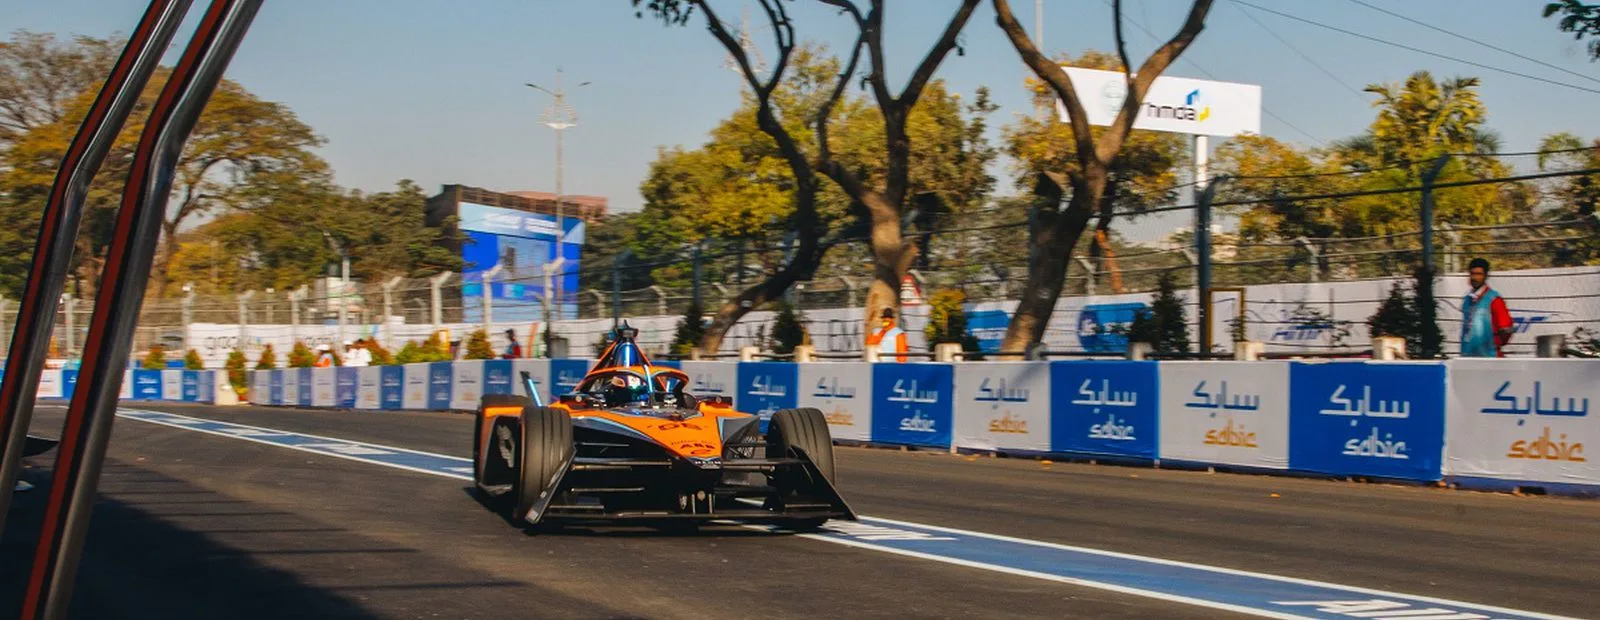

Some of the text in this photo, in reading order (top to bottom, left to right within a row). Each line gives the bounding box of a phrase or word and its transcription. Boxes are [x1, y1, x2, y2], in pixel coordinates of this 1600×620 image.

[1184, 380, 1260, 417] سابك
[1319, 385, 1410, 426] سابك
[1481, 381, 1588, 426] سابك
[988, 410, 1029, 434] sabic
[1088, 414, 1136, 440] sabic
[1202, 420, 1258, 447] sabic
[1342, 427, 1409, 459] sabic
[1507, 427, 1586, 462] sabic
